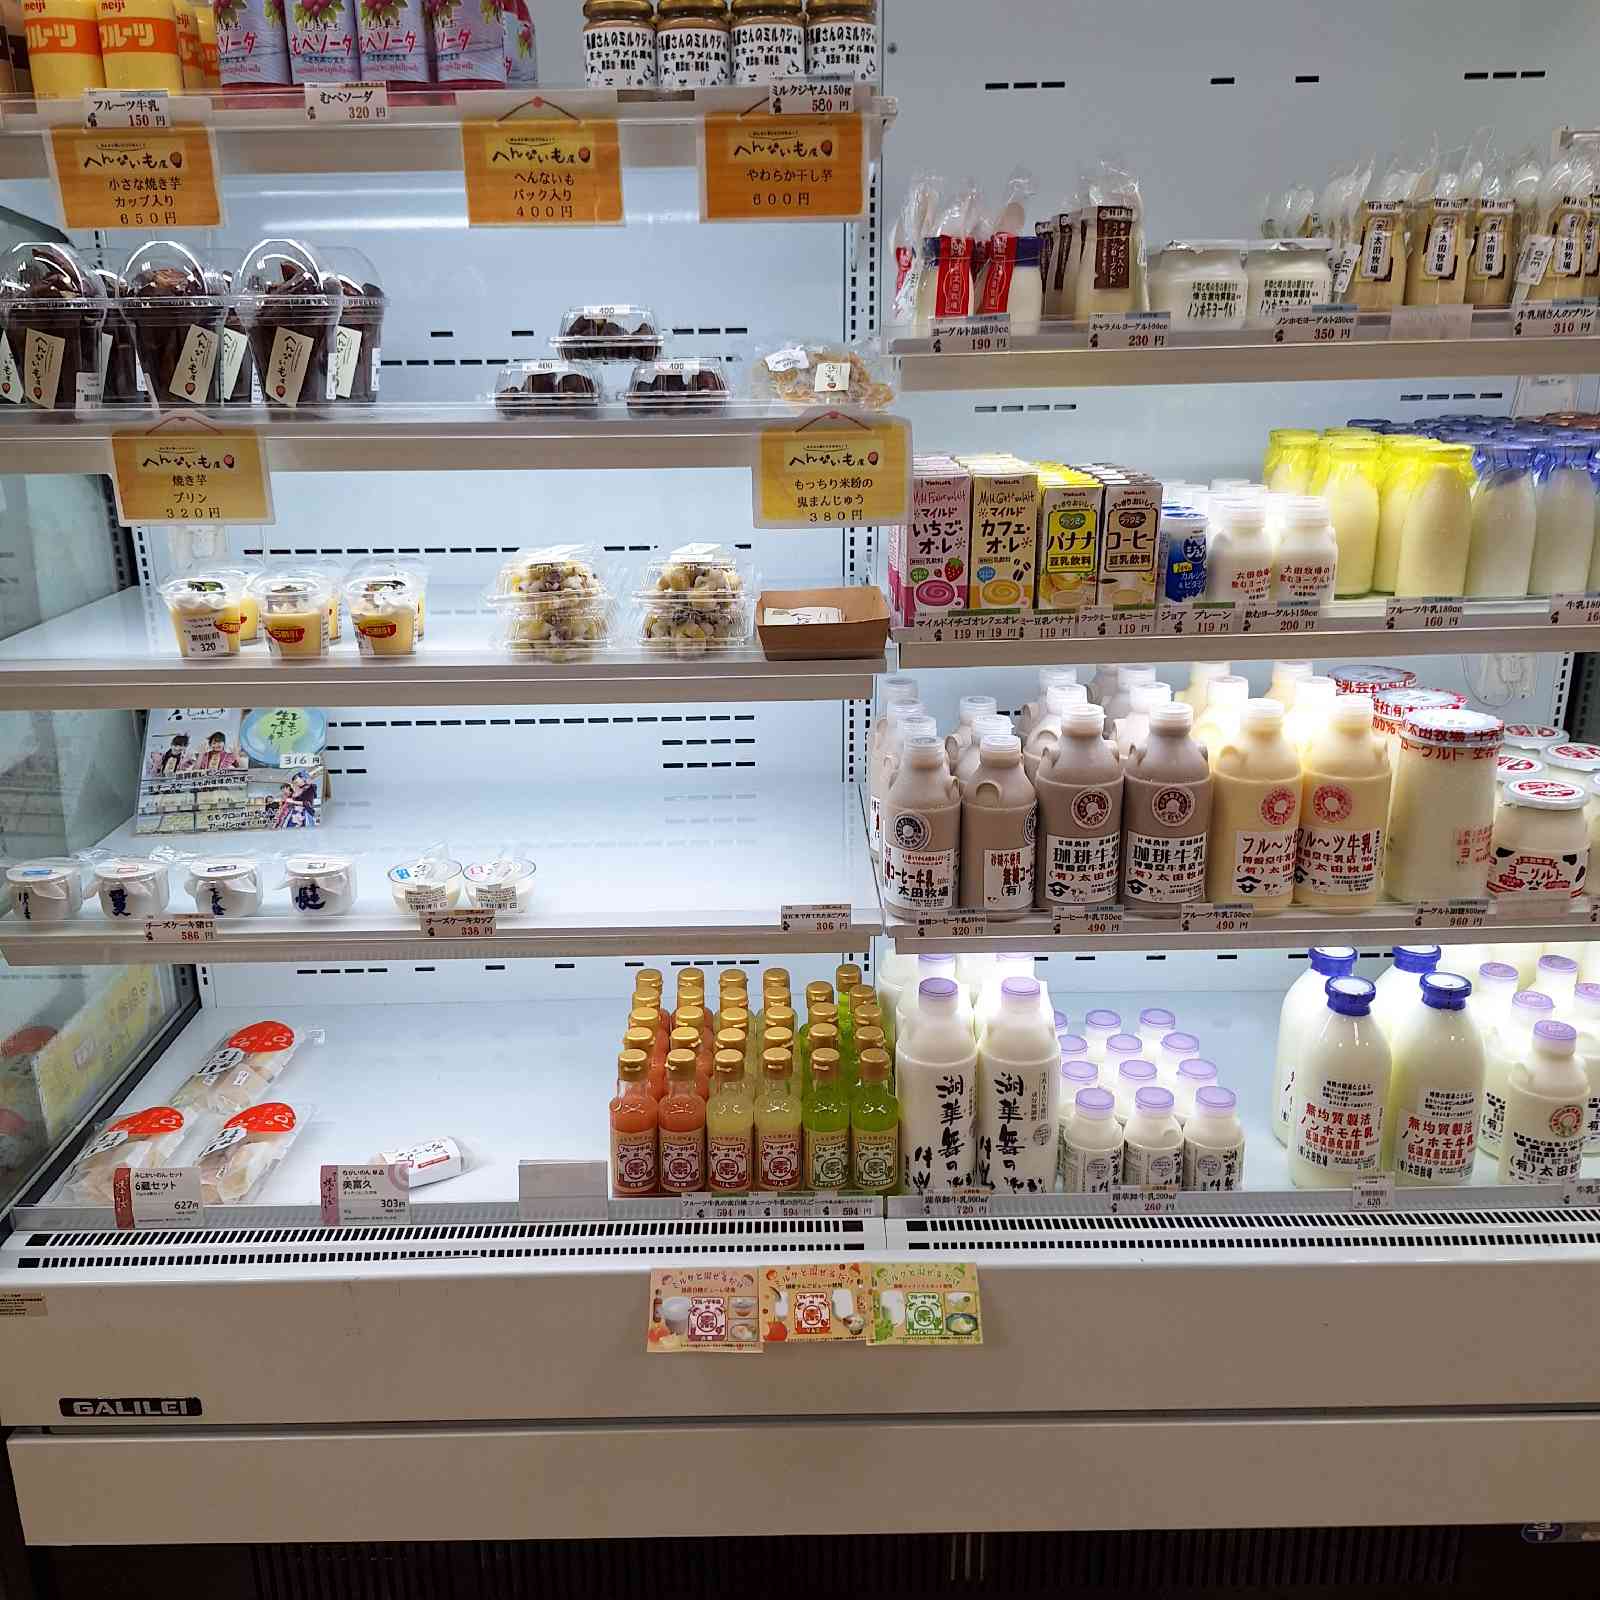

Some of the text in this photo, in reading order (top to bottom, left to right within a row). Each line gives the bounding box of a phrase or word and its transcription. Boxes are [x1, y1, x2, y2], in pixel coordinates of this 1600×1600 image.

[320, 89, 374, 105] むべソーダ
[93, 99, 160, 113] フルーツ牛乳
[109, 175, 182, 191] 小さな焼き芋
[514, 172, 575, 186] へんないも
[746, 169, 833, 183] やわらか干し芋
[114, 194, 175, 208] カップ入り
[513, 188, 573, 202] パック入り
[172, 474, 208, 488] 焼き芋
[794, 477, 874, 489] もっちり米粉の
[173, 492, 208, 504] プリン
[797, 494, 865, 508] 鬼まんじゅう
[920, 507, 958, 518] マイルド
[990, 506, 1026, 518] マイルド
[1046, 531, 1096, 551] バナナ
[1106, 530, 1155, 550] コーヒー
[1160, 610, 1232, 621] ジョア プレーン
[898, 886, 949, 898] 太田牧場
[1306, 1103, 1371, 1127] 無均質製法
[1407, 1116, 1473, 1136] 無均質製法
[135, 1180, 177, 1191] 6蔵セット
[72, 1401, 188, 1416] GALILEI
